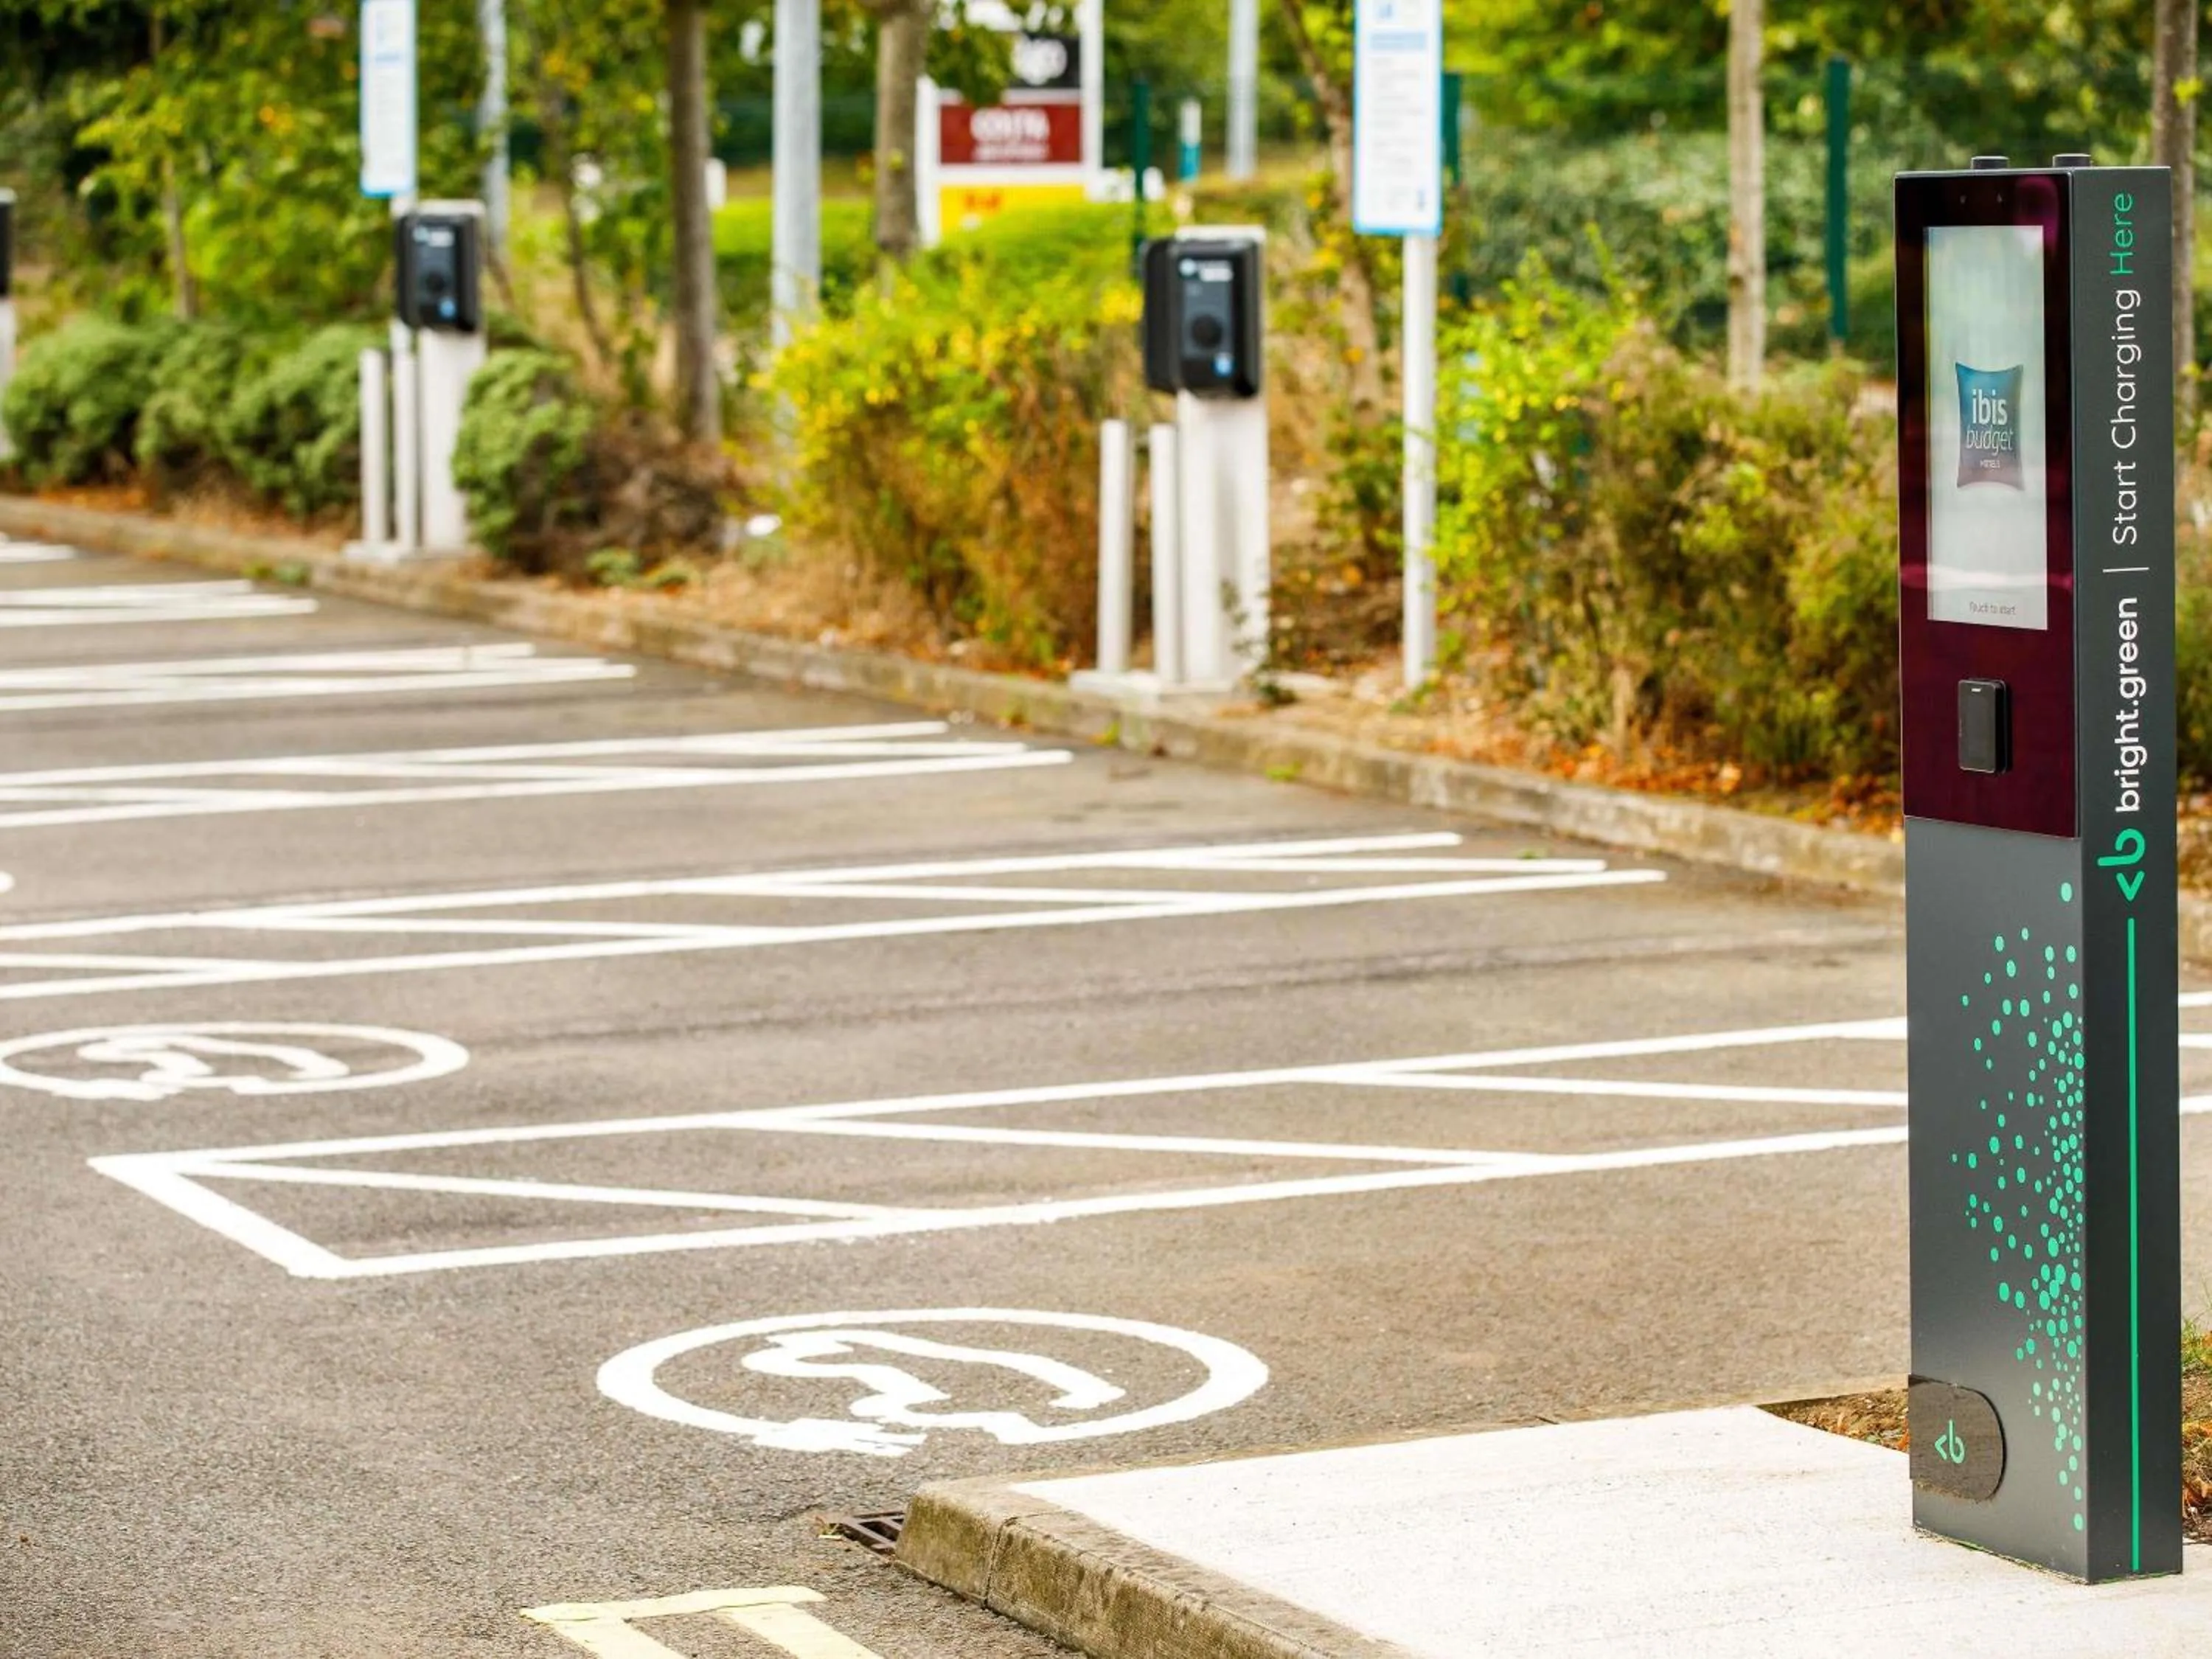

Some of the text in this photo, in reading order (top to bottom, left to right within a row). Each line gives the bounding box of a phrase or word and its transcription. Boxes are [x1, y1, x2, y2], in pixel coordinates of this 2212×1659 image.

[2110, 193, 2133, 274] Here
[1971, 389, 2008, 425] ibis
[2110, 289, 2141, 448] Charging
[1965, 424, 2014, 456] budget
[2112, 460, 2137, 544] Start
[2114, 597, 2147, 812] bright.green
